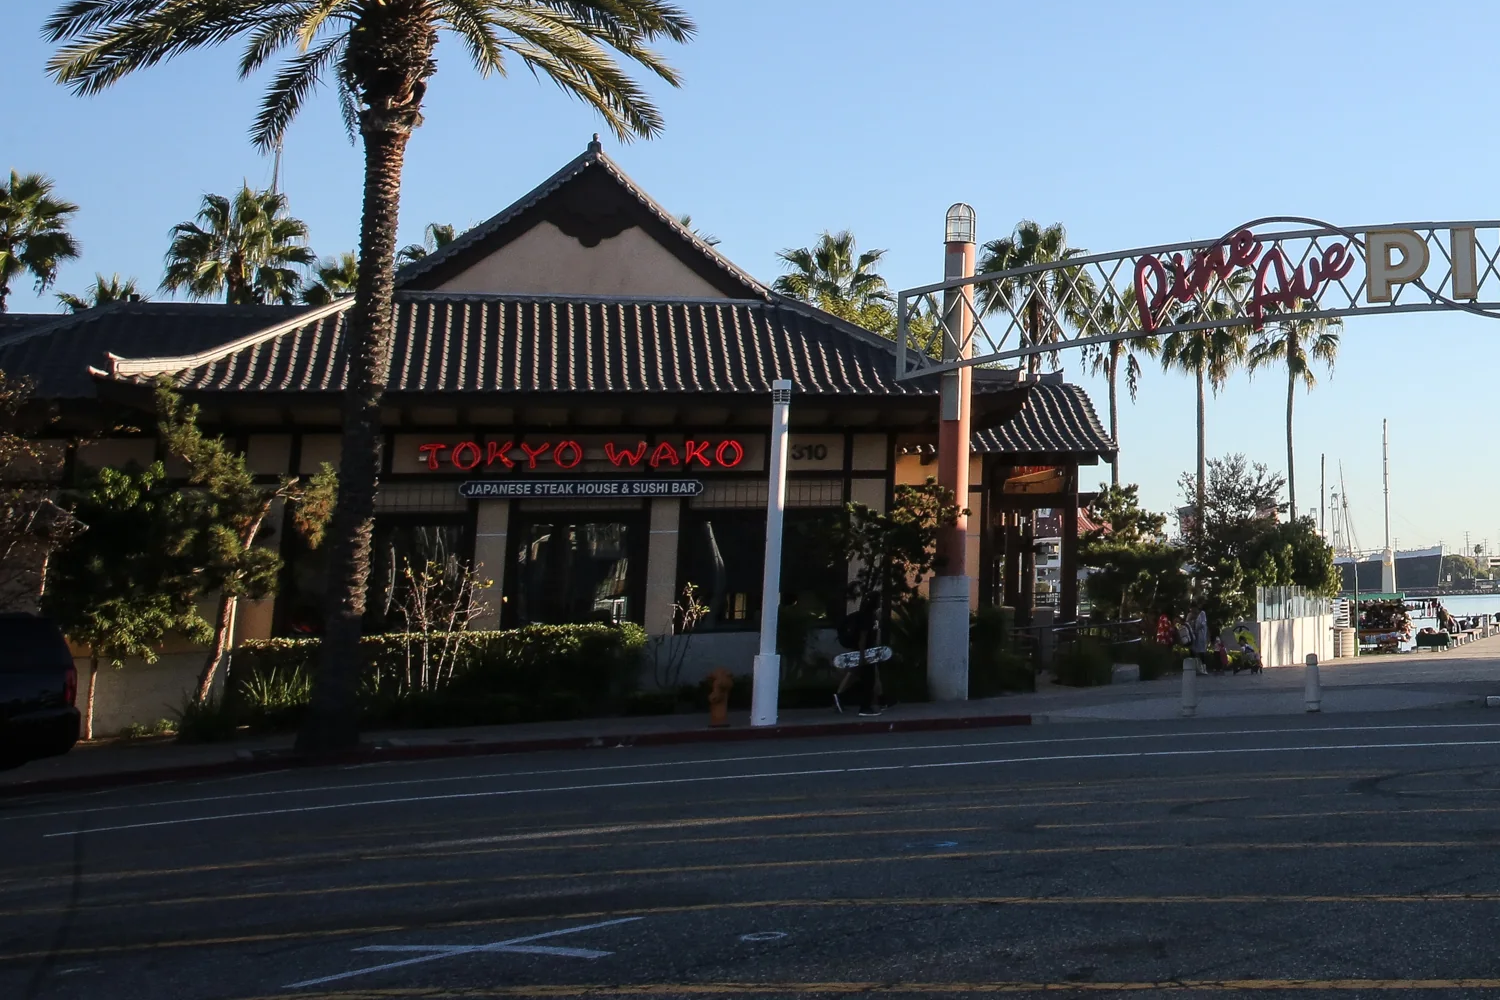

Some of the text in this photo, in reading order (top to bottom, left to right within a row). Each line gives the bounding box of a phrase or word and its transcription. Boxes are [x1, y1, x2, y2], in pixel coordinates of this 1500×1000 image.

[1134, 229, 1264, 333] Pine
[1246, 242, 1356, 332] Ave
[419, 439, 745, 470] TOKYO WAKO
[791, 443, 828, 461] 310
[467, 482, 696, 495] JAPANESE STEAK HOUSE & SUSHI BAR
